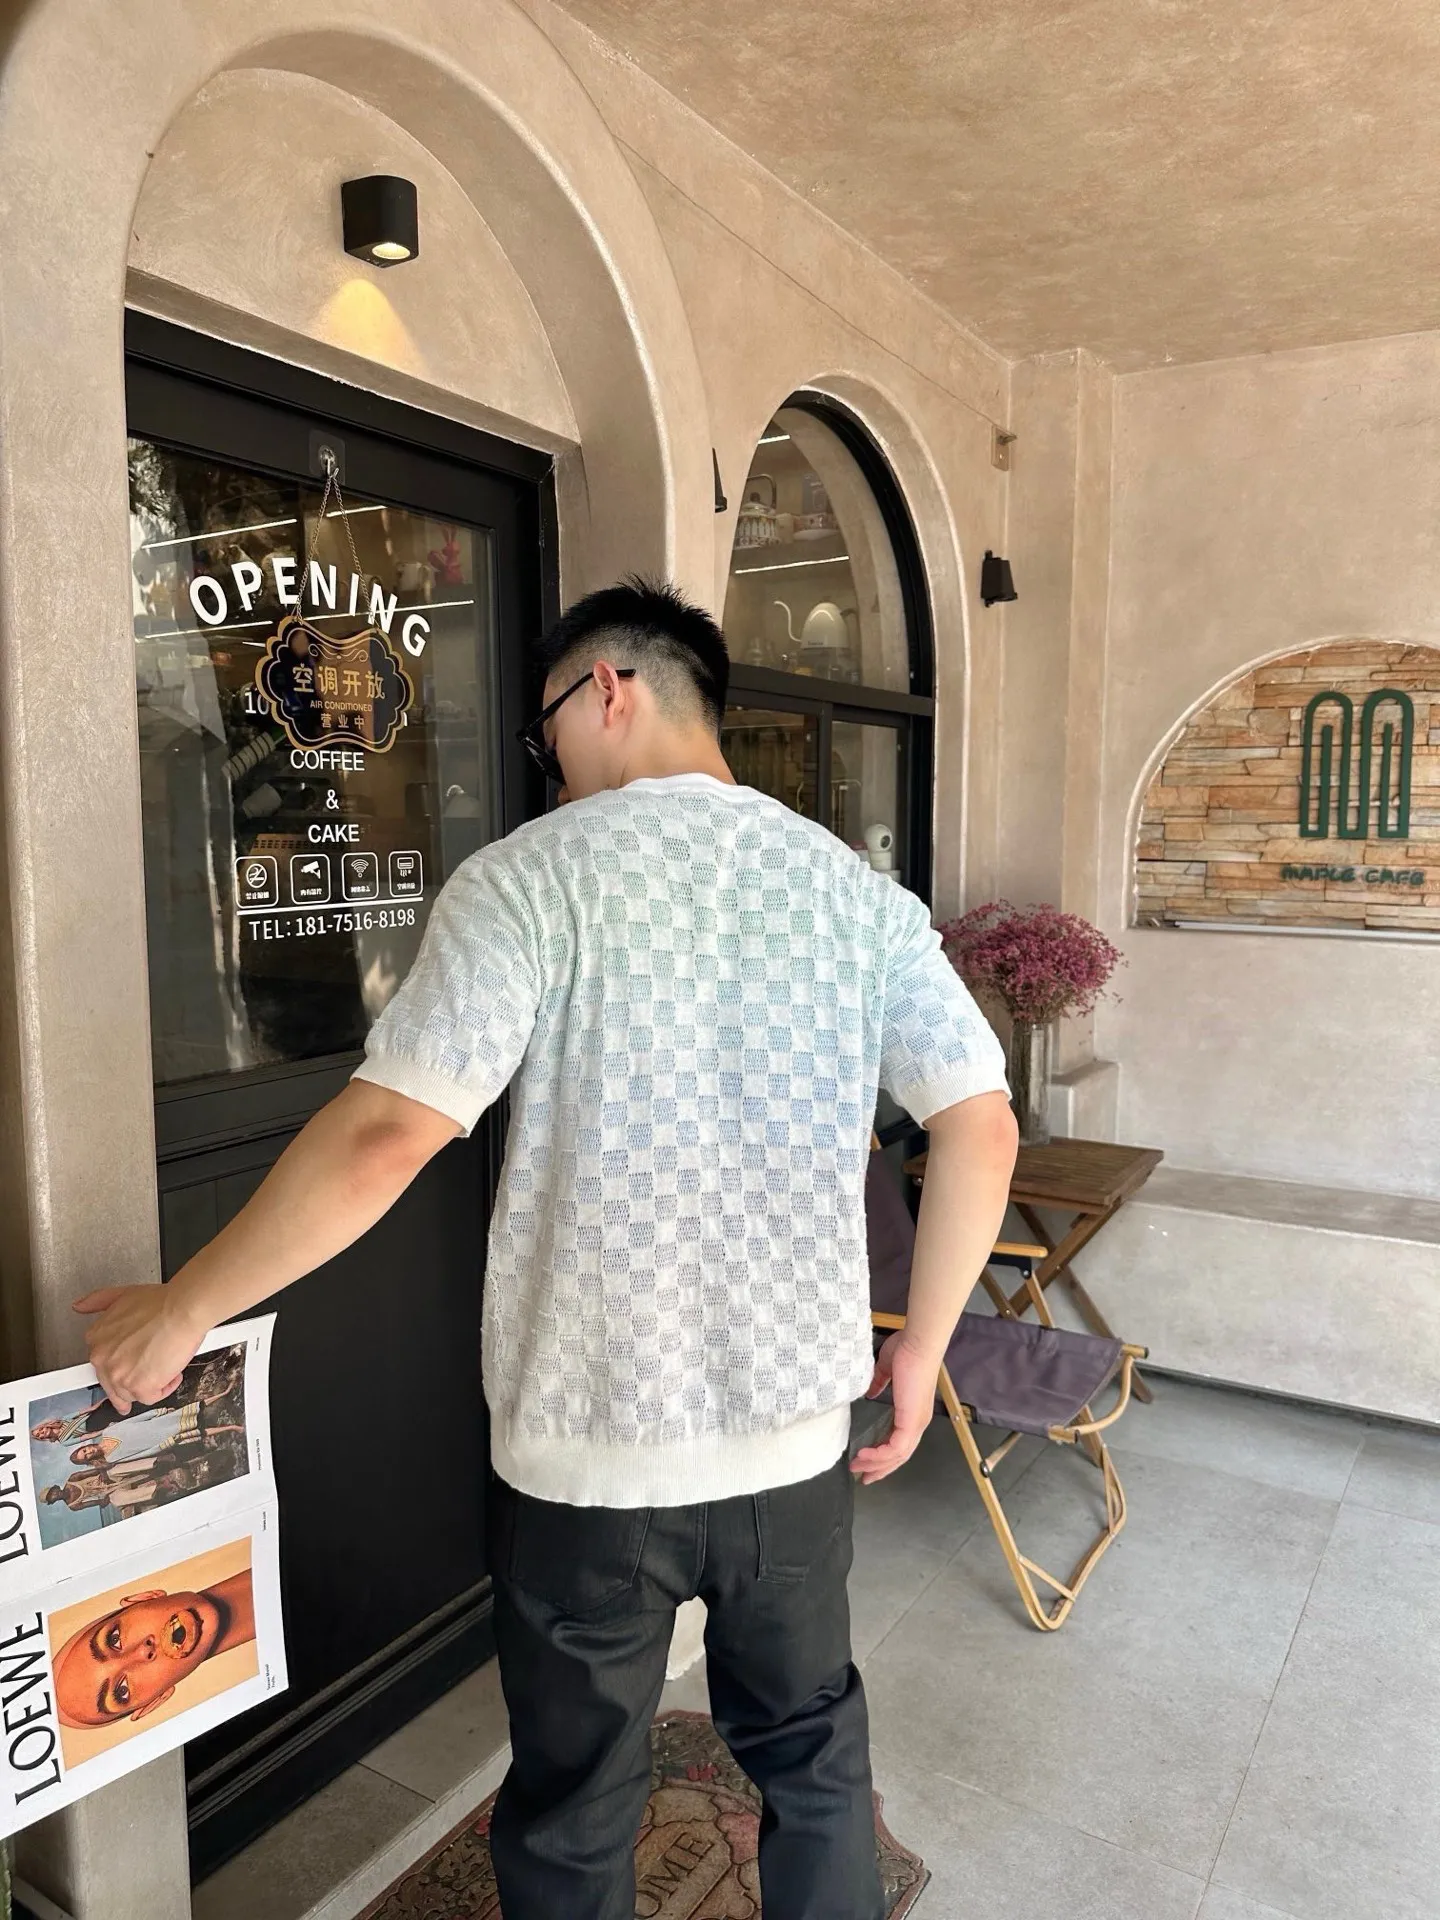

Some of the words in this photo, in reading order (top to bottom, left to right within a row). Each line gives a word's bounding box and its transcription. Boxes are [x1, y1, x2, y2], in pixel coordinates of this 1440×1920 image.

[189, 557, 430, 657] OPENING
[292, 663, 386, 700] 空调开放
[310, 700, 323, 709] AIR
[324, 701, 373, 712] CONDITIONED
[320, 713, 365, 730] 营业中
[290, 749, 365, 771] COFFEE
[325, 789, 340, 810] &
[307, 823, 360, 844] CAKE
[0, 1611, 62, 1806] LOEWE
